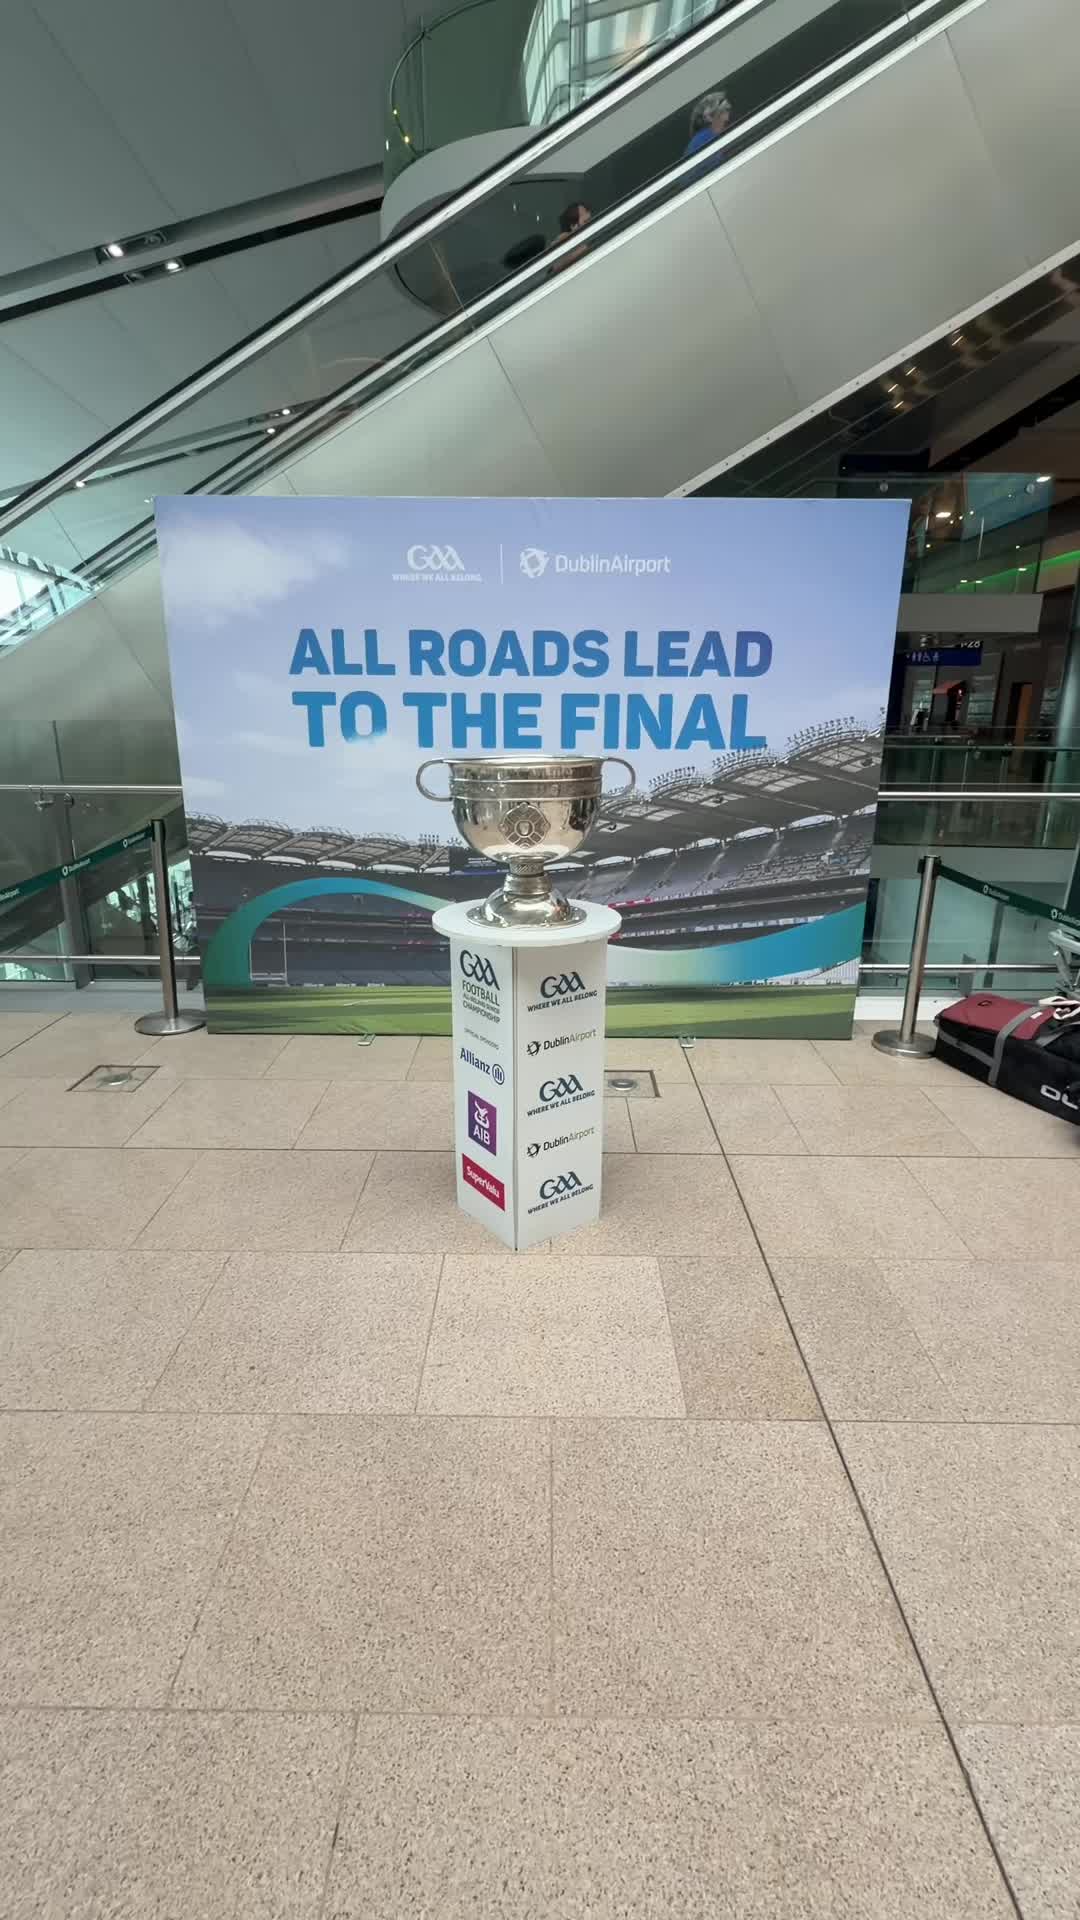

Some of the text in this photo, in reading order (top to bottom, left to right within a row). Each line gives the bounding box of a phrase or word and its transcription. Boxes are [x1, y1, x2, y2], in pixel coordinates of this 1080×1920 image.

[407, 545, 466, 571] GAA
[555, 553, 672, 577] DublinAirport
[289, 628, 773, 678] ALL ROADS LEAD
[291, 690, 767, 750] TO THE FINAL
[460, 949, 500, 991] GAA
[462, 980, 500, 1007] FOOTBALL
[540, 971, 586, 999] GAA
[527, 989, 598, 1013] WHERE WE ALL BELONG
[543, 1028, 597, 1051] DublinAirport
[460, 1047, 491, 1076] Allianz
[539, 1074, 584, 1102] GAA
[527, 1090, 596, 1117] WHERE WE ALL BELONG
[473, 1124, 491, 1146] AIB
[543, 1126, 595, 1151] DublinAirport
[466, 1165, 500, 1199] SuperValu
[539, 1171, 583, 1200] GAA
[527, 1183, 594, 1215] WHERE WE ALL BELONG
